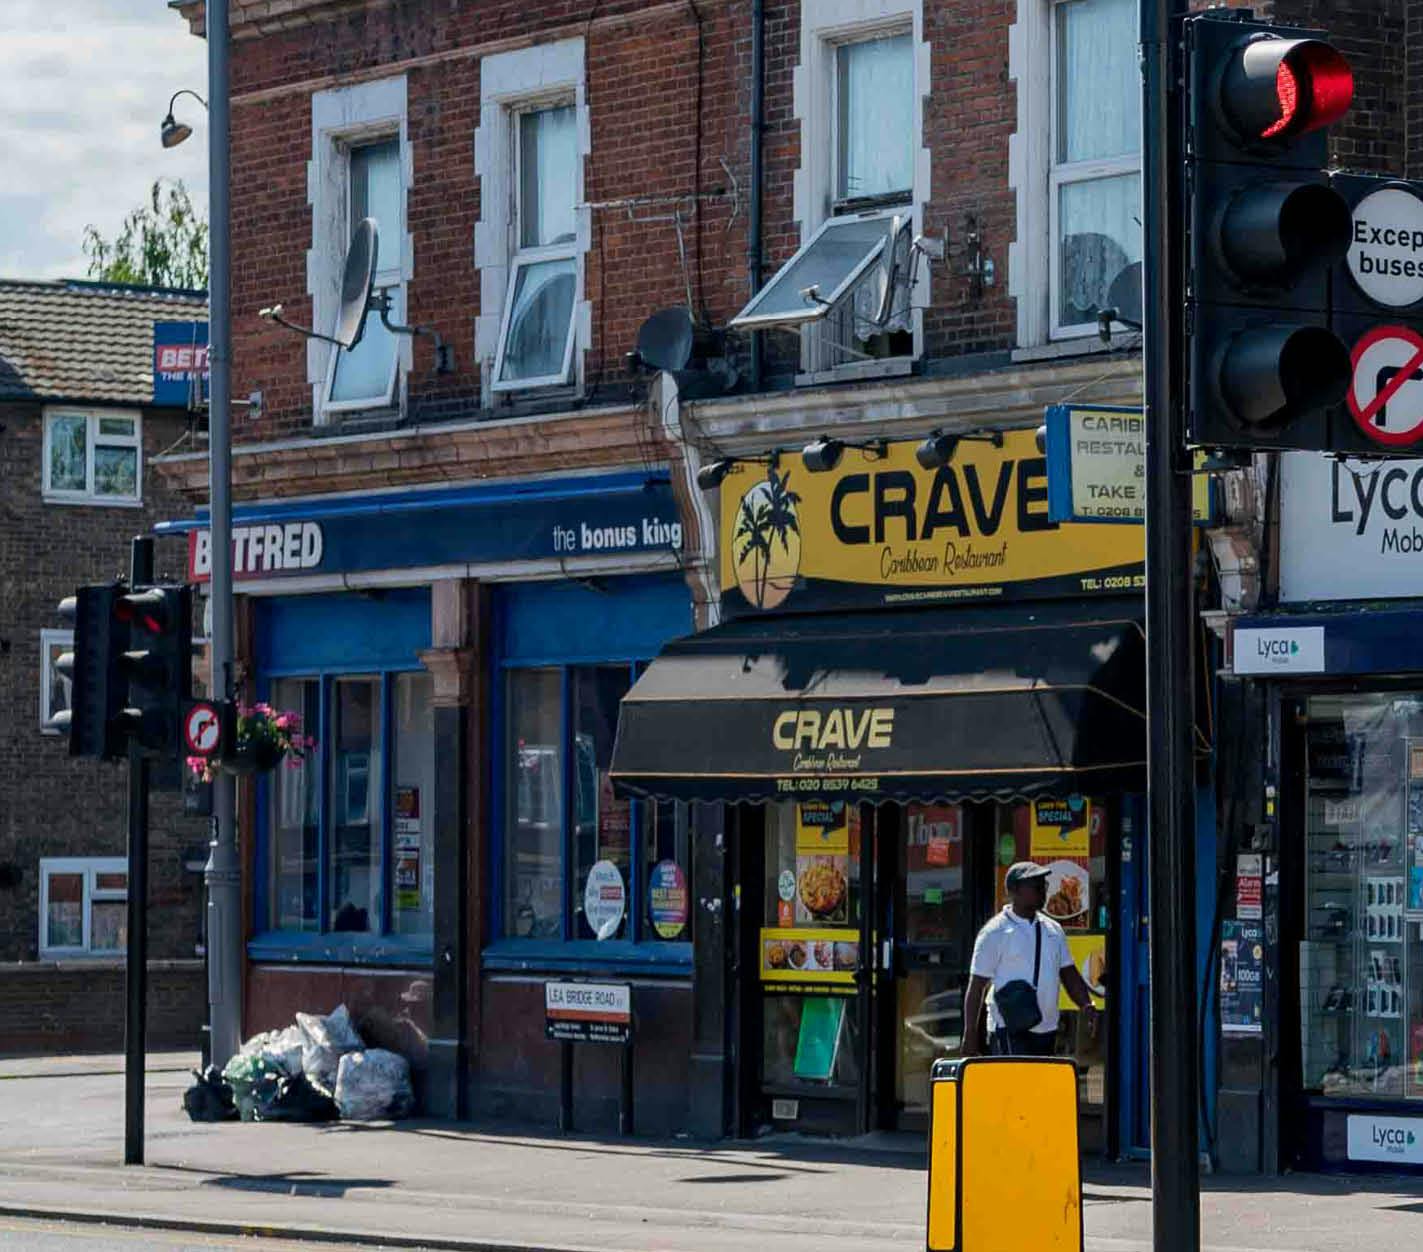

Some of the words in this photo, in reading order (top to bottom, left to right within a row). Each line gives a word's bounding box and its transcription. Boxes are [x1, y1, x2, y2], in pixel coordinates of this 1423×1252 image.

[829, 458, 1060, 545] CRAVE
[1087, 484, 1136, 499] TAKE
[553, 525, 576, 552] the
[581, 522, 637, 550] bonus
[643, 517, 683, 549] king
[195, 522, 323, 577] BTFRED
[880, 546, 939, 579] Caribbean
[943, 541, 1008, 576] Restaurant
[1081, 578, 1102, 591] TEL:
[1104, 577, 1131, 589] 0208
[1258, 636, 1288, 659] Lyca
[773, 708, 895, 750] CRAVE
[1241, 926, 1258, 939] Lyca
[550, 988, 563, 1002] LEA
[566, 990, 592, 1005] BRIDGE
[594, 991, 616, 1006] ROAD
[1372, 1123, 1405, 1147] Lyca
